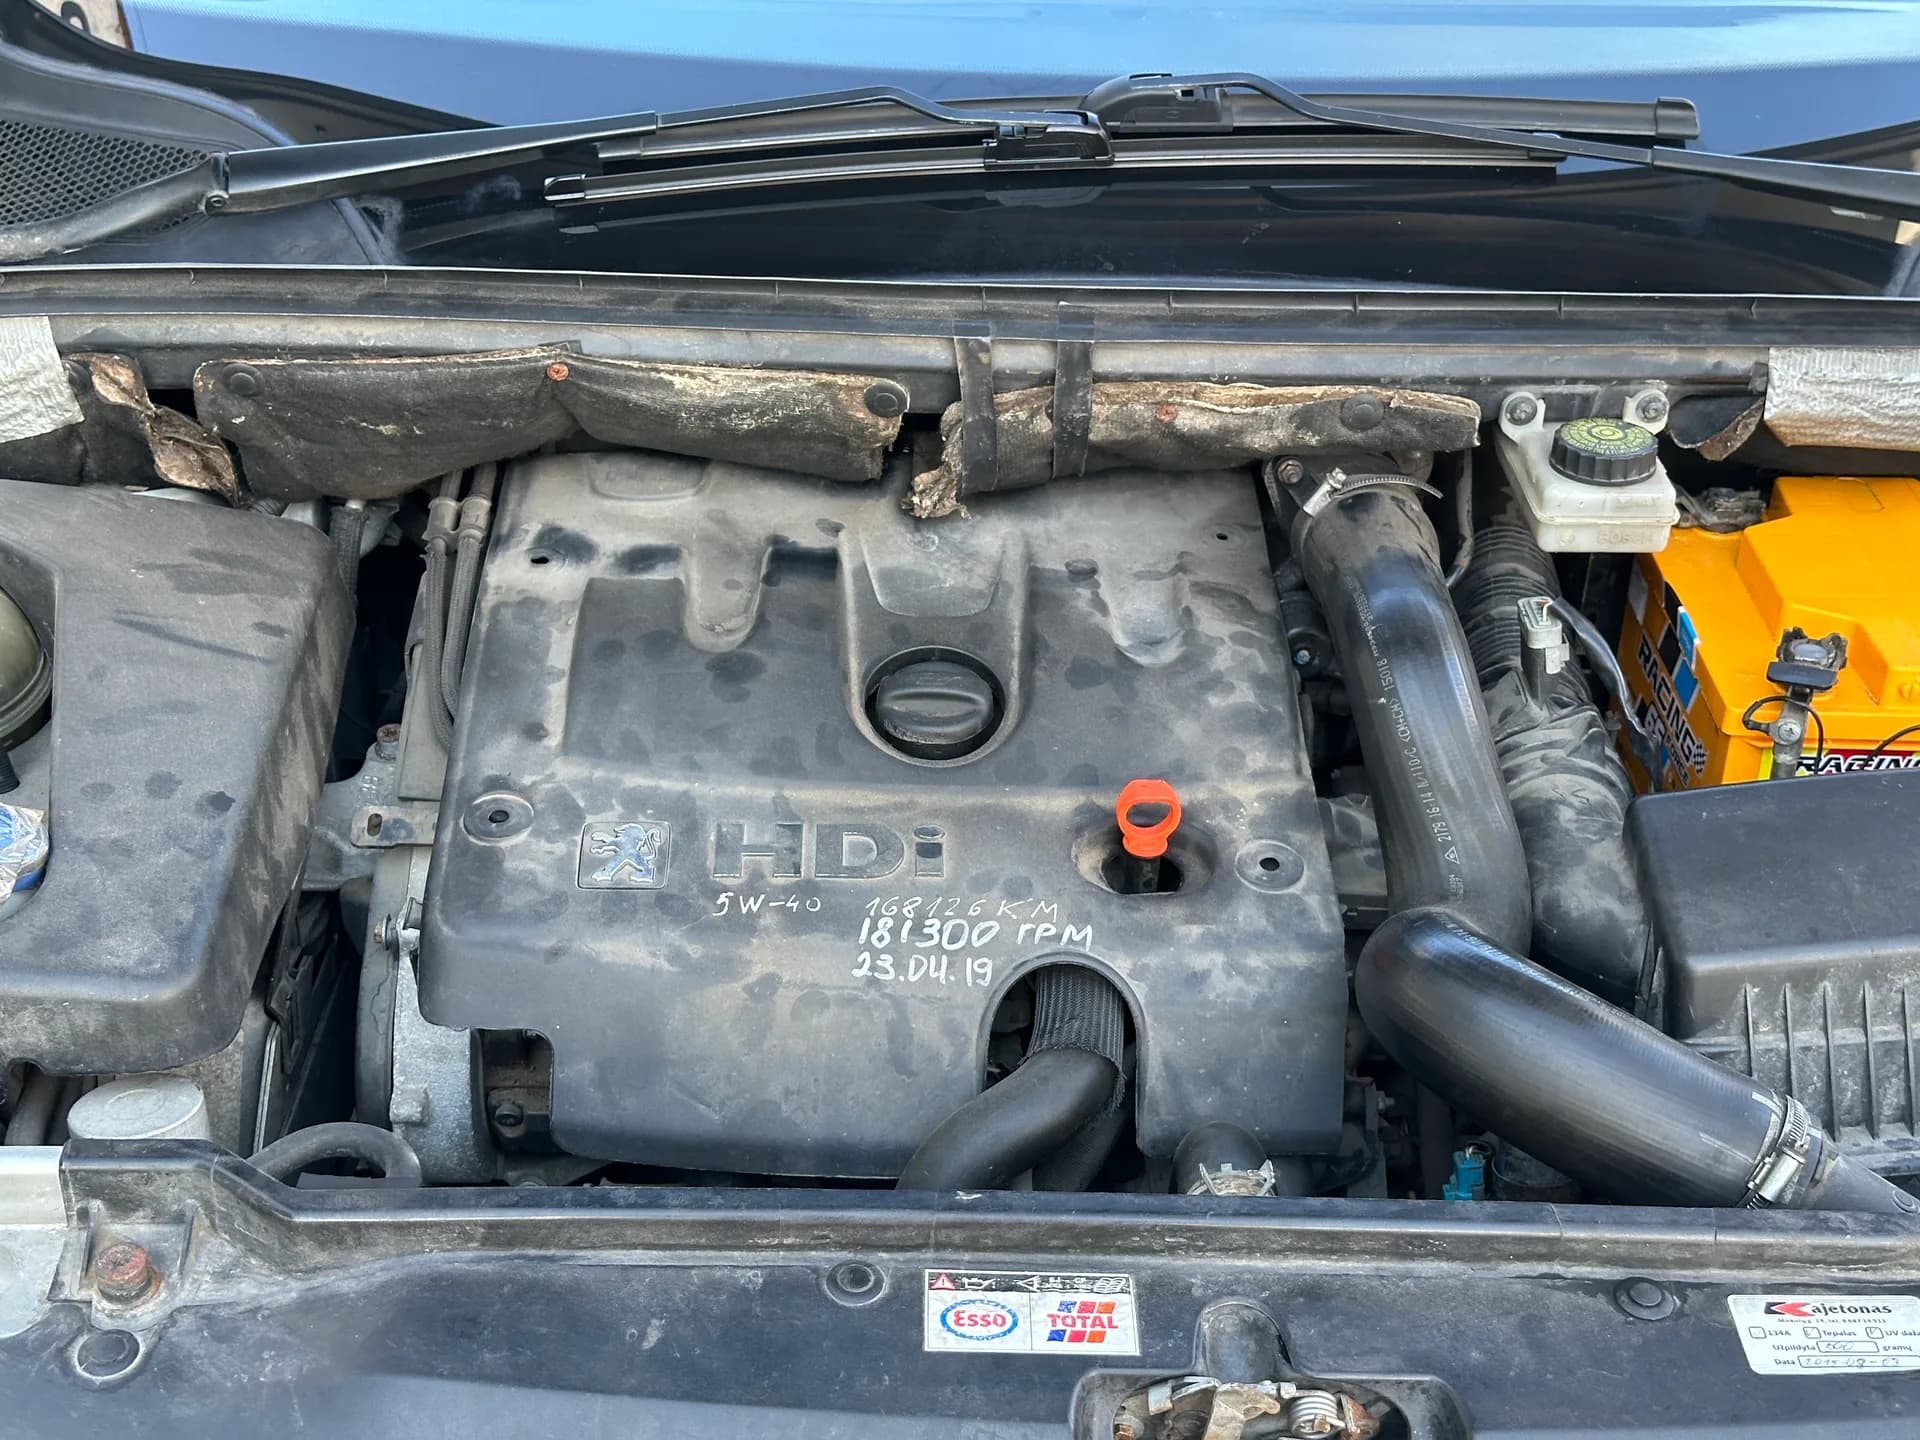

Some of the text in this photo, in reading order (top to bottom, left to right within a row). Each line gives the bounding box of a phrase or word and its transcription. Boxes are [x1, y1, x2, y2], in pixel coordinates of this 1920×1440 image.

[1637, 630, 1696, 766] RACING
[713, 823, 946, 878] HDi
[865, 896, 982, 917] 168126
[858, 916, 1001, 950] 181300
[851, 951, 994, 987] 23.04.19
[1764, 1302, 1893, 1317] Kajetonas
[1047, 1313, 1119, 1329] TOTAL
[1822, 1330, 1857, 1338] Tepalas
[1774, 1358, 1796, 1366] Data
